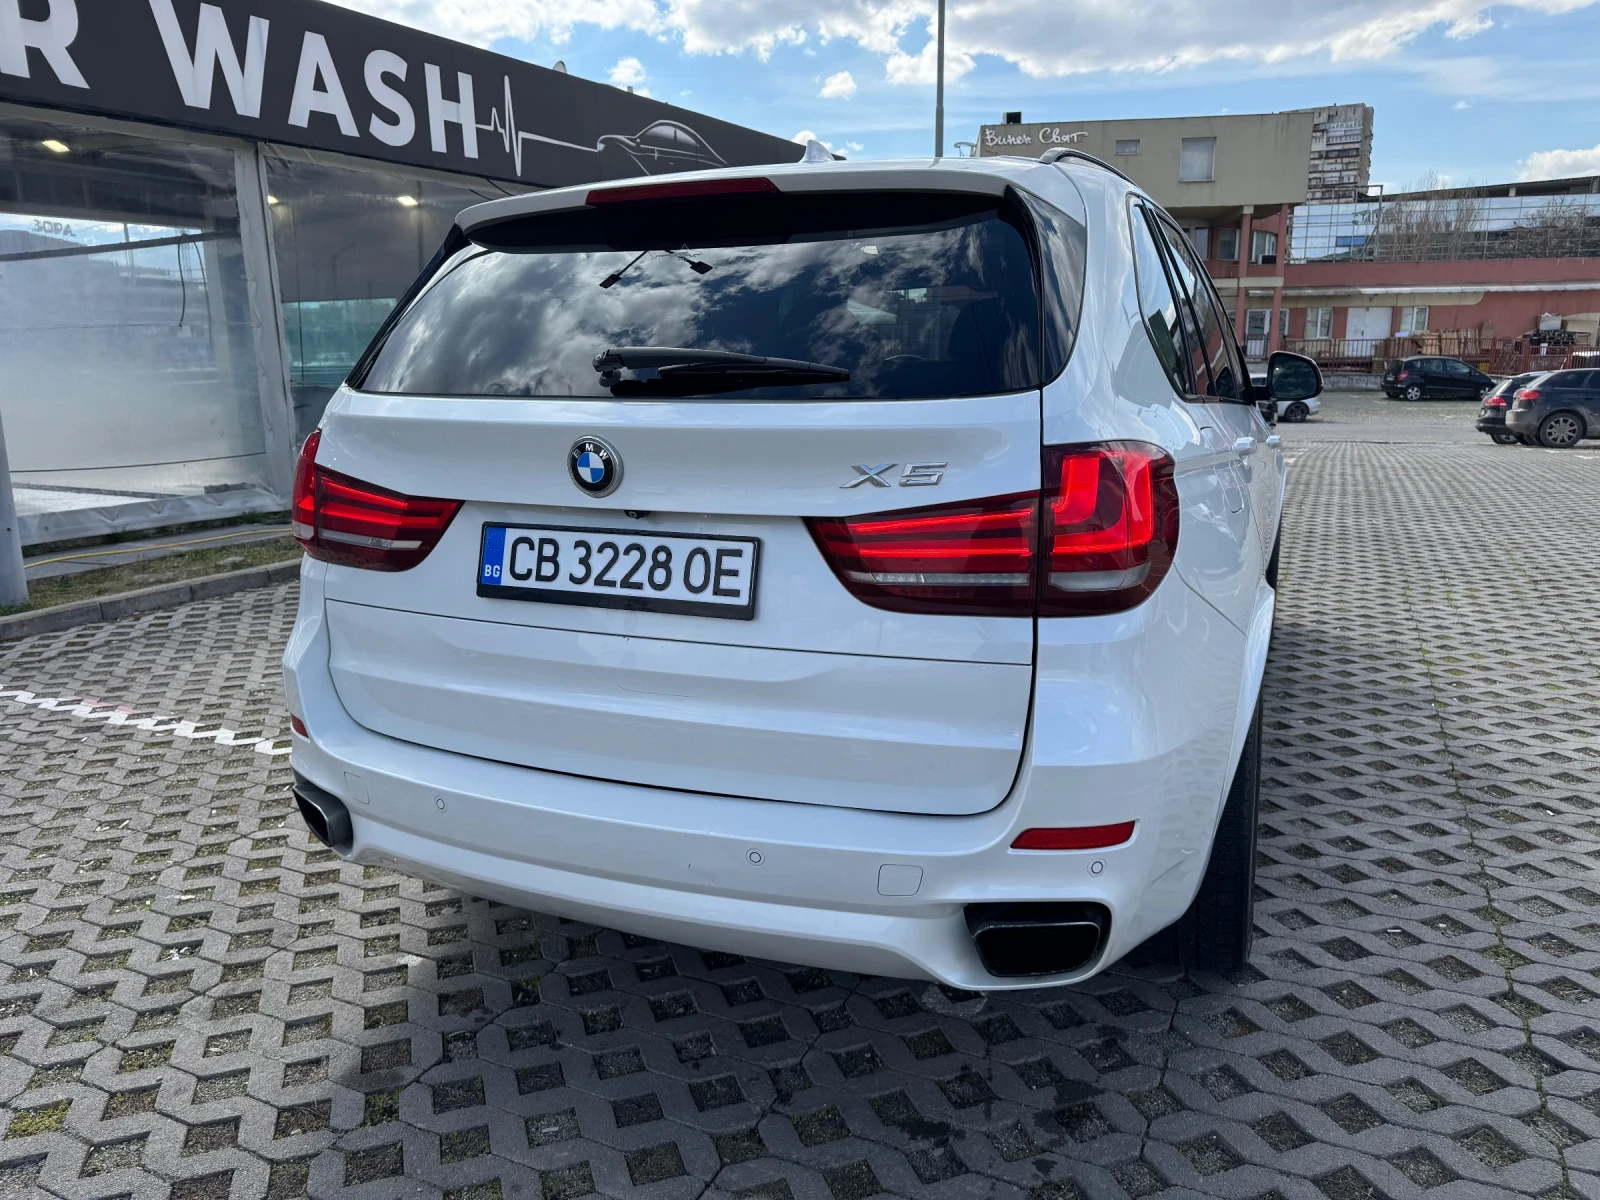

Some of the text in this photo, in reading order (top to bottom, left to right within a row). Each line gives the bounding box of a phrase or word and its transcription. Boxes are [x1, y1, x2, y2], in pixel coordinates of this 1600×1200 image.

[148, 0, 479, 159] WASH
[573, 442, 610, 460] BMW
[839, 462, 948, 489] X5
[484, 564, 501, 578] BG
[509, 536, 560, 582] CB
[568, 539, 673, 592] 3228
